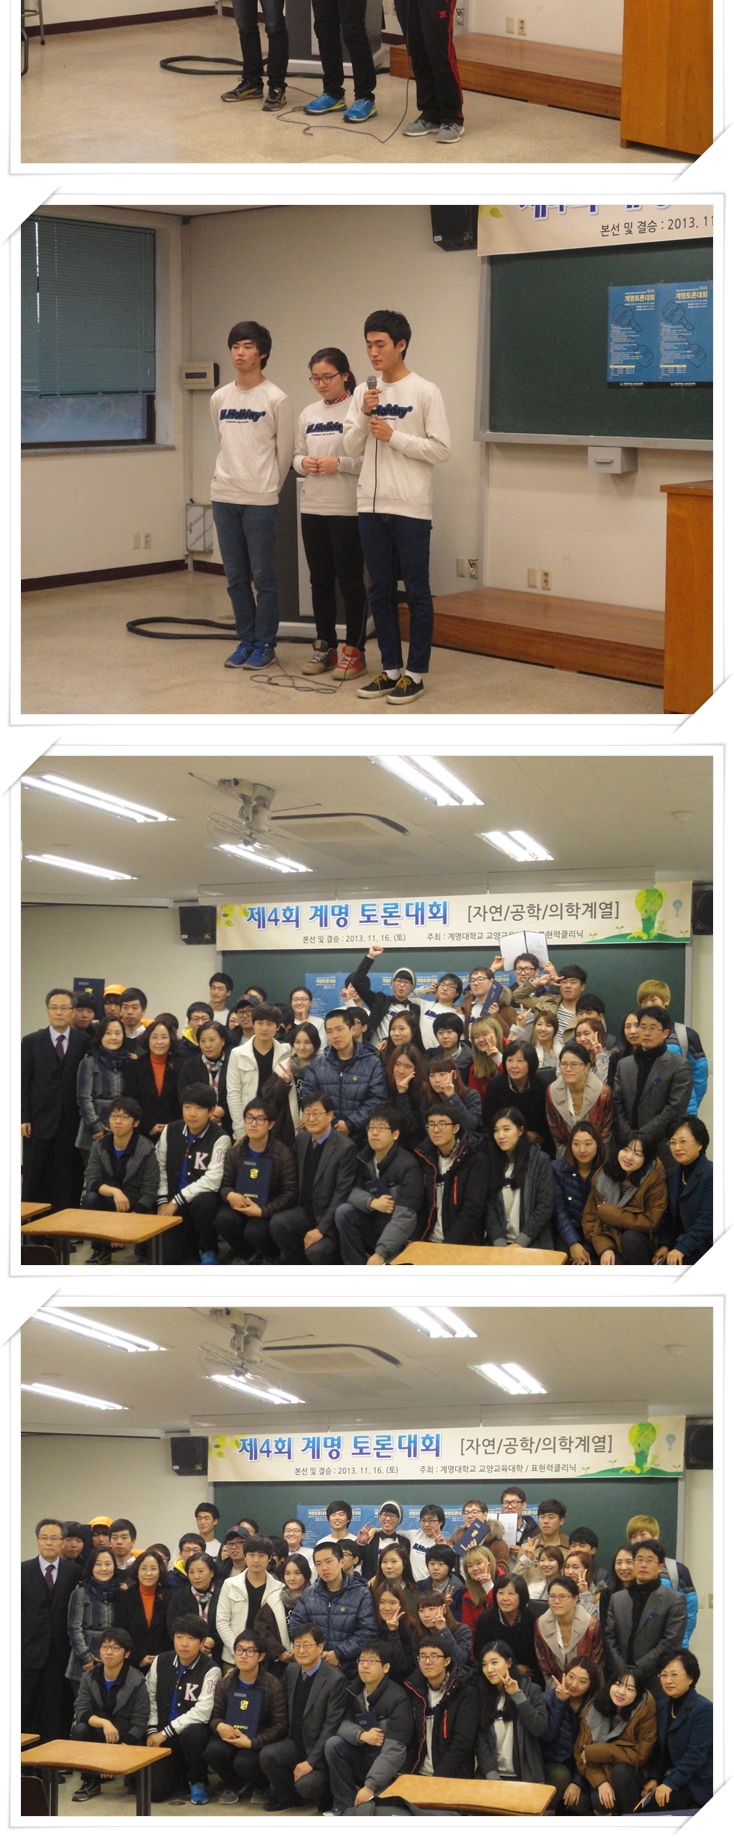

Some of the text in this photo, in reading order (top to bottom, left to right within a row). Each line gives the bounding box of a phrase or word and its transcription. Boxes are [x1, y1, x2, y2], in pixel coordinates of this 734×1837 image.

[600, 223, 620, 237] 본선
[624, 222, 633, 235] 및
[637, 220, 657, 234] 결승
[668, 217, 698, 230] 2013.
[247, 901, 619, 929] 제4회 계명 토론대회 [자연/공학/의학계열]
[303, 936, 316, 944] 본선
[327, 935, 339, 943] 결승
[393, 934, 406, 942] (토)
[427, 933, 440, 941] 주최
[448, 932, 483, 941] 계명대학교
[194, 1152, 208, 1170] K
[239, 1433, 612, 1461] 제4회 계명 토론대회 [자연/공학/의학계열]
[310, 1467, 316, 1475] 및
[319, 1467, 331, 1475] 결승
[386, 1466, 398, 1474] (토)
[419, 1465, 433, 1473] 주최
[440, 1465, 476, 1473] 계명대학교
[479, 1465, 523, 1473] 교양교육대학
[531, 1464, 576, 1473] 표현력클리닉
[184, 1683, 199, 1701] K
